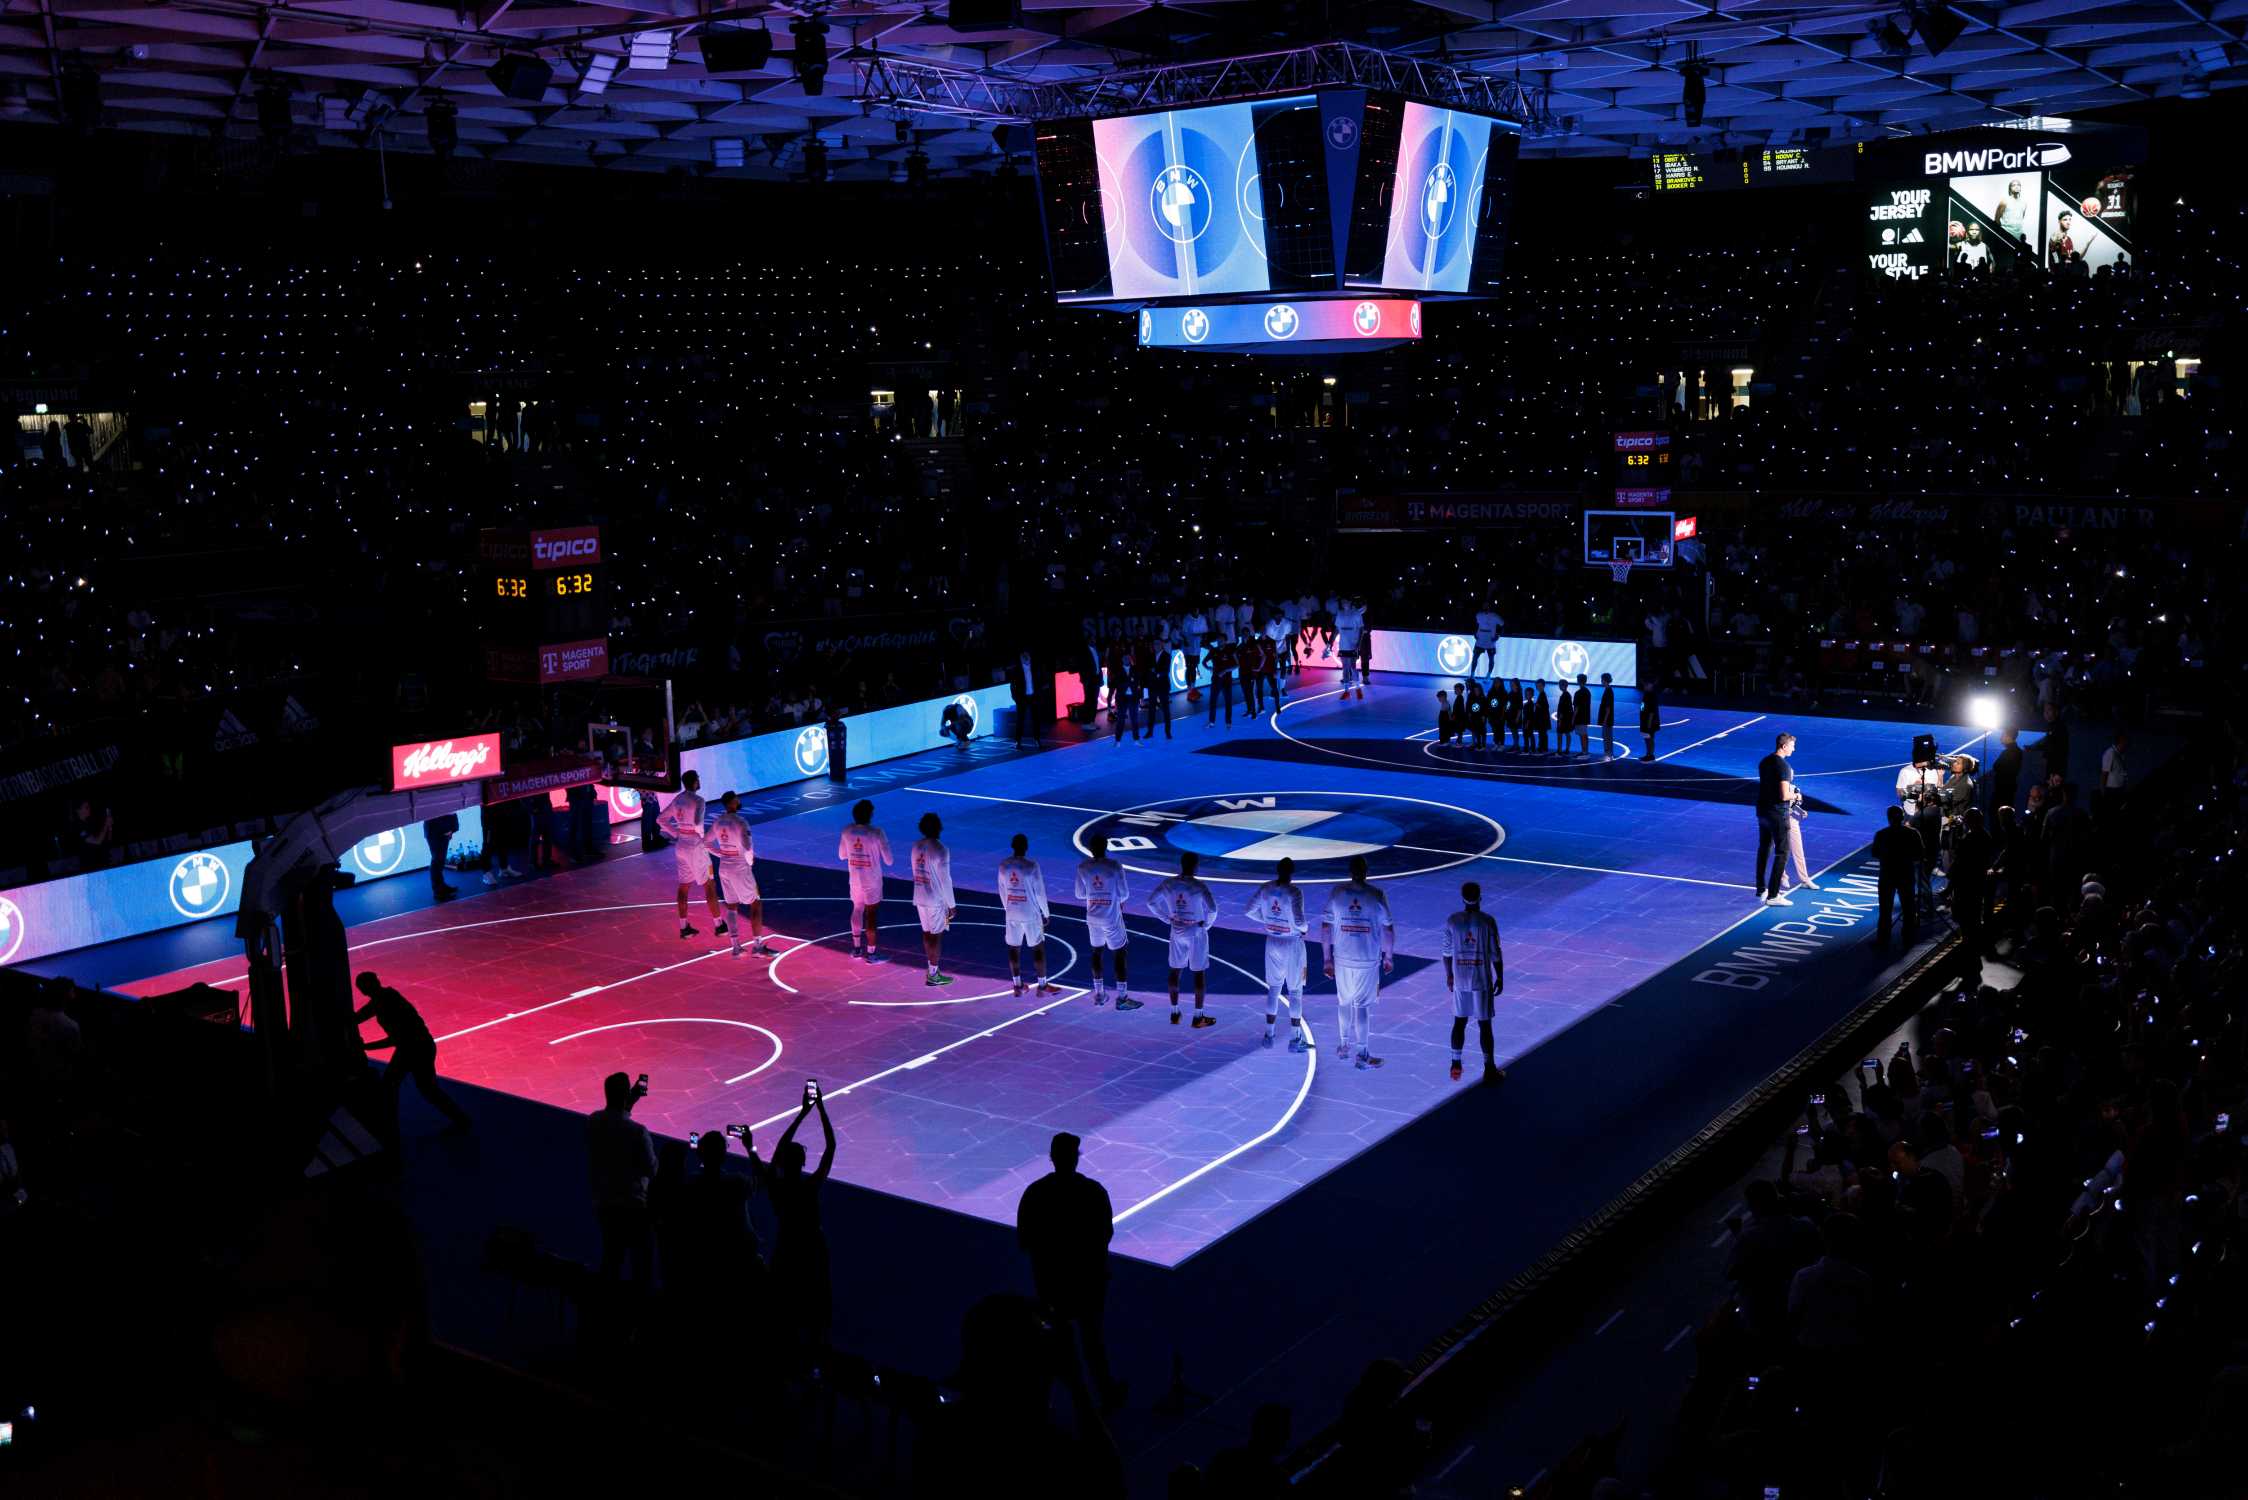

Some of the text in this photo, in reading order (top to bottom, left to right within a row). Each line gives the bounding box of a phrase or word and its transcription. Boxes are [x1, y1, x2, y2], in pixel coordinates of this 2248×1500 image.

[1925, 146, 2039, 175] BMWPark
[1156, 169, 1199, 193] BMW
[1891, 189, 1931, 205] YOUR
[1870, 204, 1926, 220] JERSEY
[1869, 253, 1908, 269] YOUR
[1616, 436, 1653, 448] tipico
[1627, 455, 1650, 465] 6:32
[2015, 504, 2154, 528] PAULANR
[534, 537, 597, 562] tipico
[497, 578, 527, 597] 6:32
[557, 573, 593, 595] 6:32
[561, 646, 605, 659] MAGENTA
[562, 658, 591, 672] SPORT
[403, 741, 490, 778] Kellogg's
[511, 773, 561, 792] MAGENTA
[561, 767, 593, 783] SPORT
[1107, 796, 1276, 851] BMW
[176, 856, 220, 879] BMW
[1691, 898, 1880, 991] BMWPark
